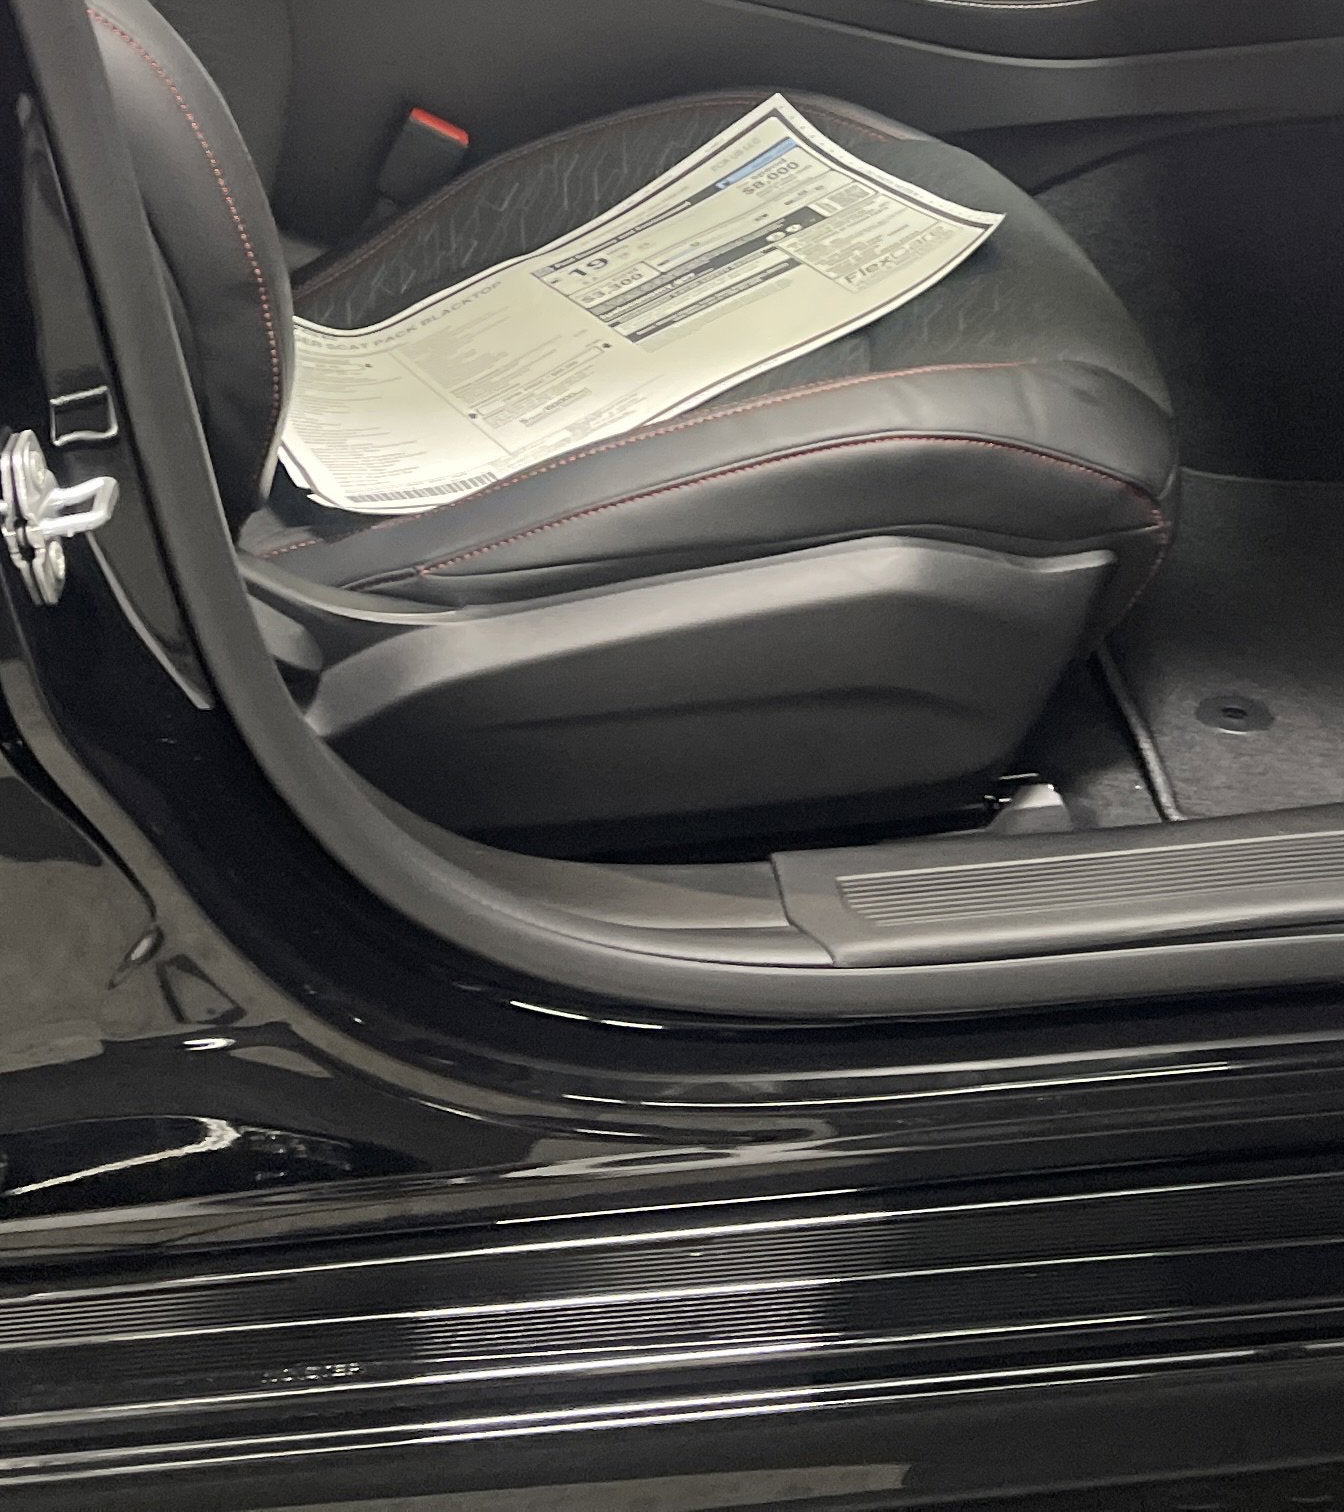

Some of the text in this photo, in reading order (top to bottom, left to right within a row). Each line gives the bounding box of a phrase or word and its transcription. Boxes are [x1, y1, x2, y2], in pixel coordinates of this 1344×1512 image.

[741, 160, 799, 195] $8,000
[568, 255, 610, 280] 19
[374, 326, 417, 346] PACK
[420, 281, 502, 326] BLACKTOP
